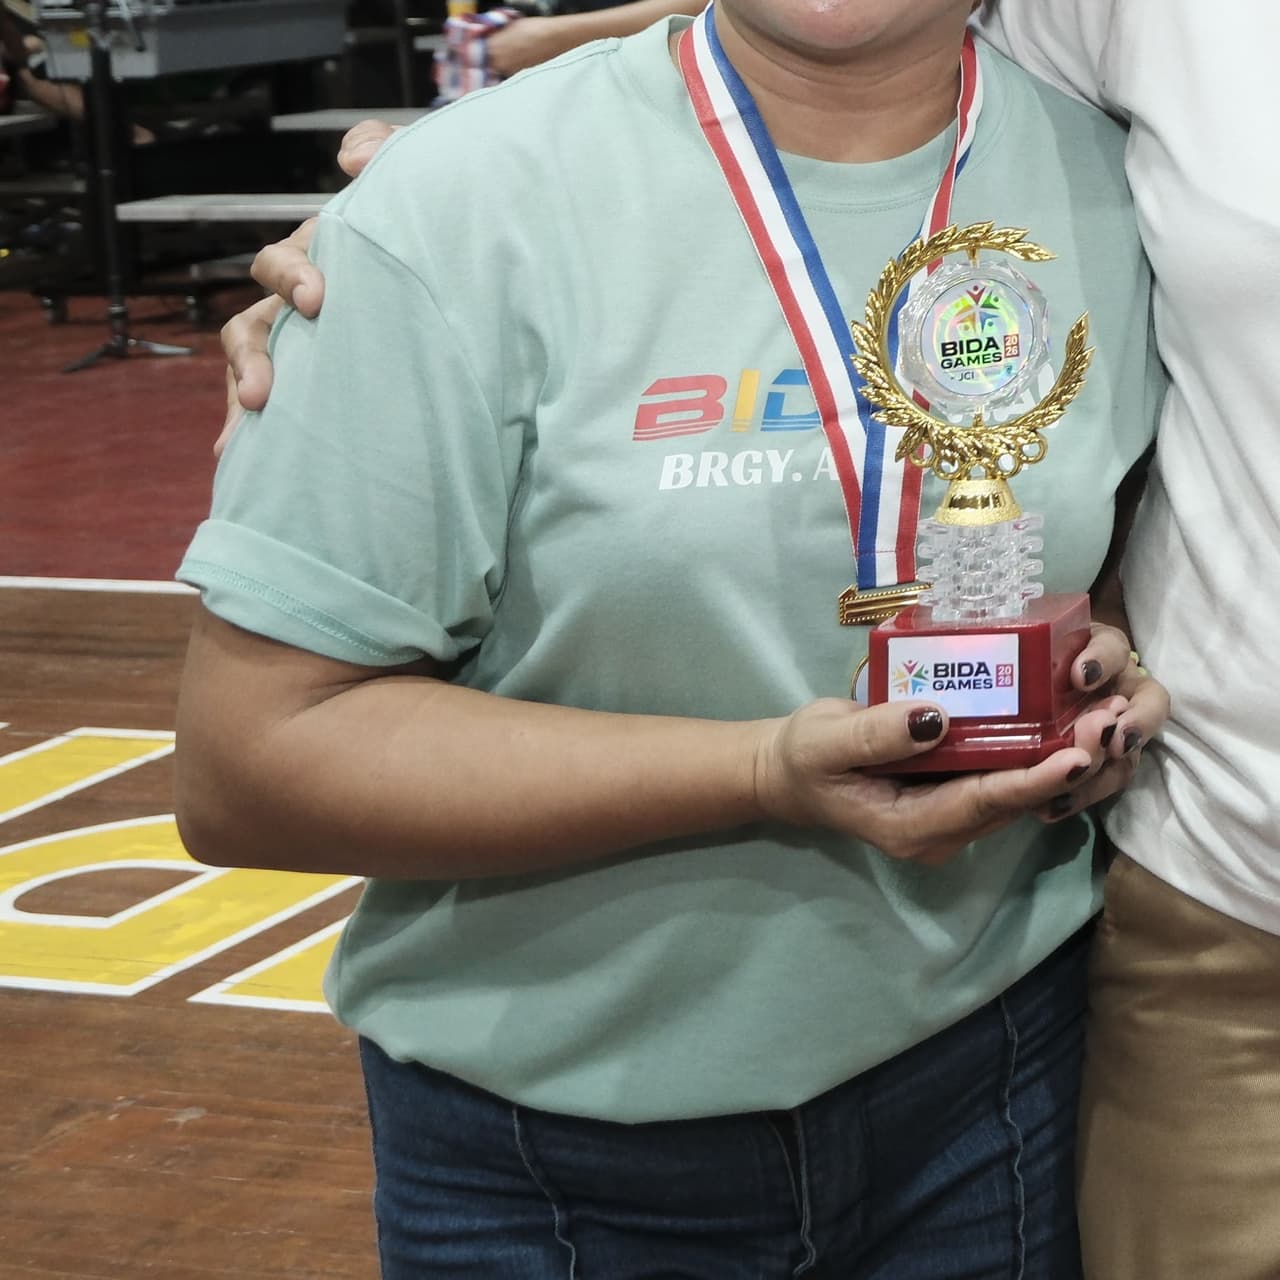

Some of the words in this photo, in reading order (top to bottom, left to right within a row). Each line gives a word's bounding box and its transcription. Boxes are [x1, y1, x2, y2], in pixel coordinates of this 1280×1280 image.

[941, 336, 1000, 357] BIDA
[1005, 336, 1018, 346] 20
[940, 352, 1003, 369] GAMES
[959, 371, 975, 381] JCI
[658, 449, 802, 490] BRGY.
[933, 661, 991, 678] BIDA
[997, 665, 1012, 676] 20
[932, 678, 993, 691] GAMES
